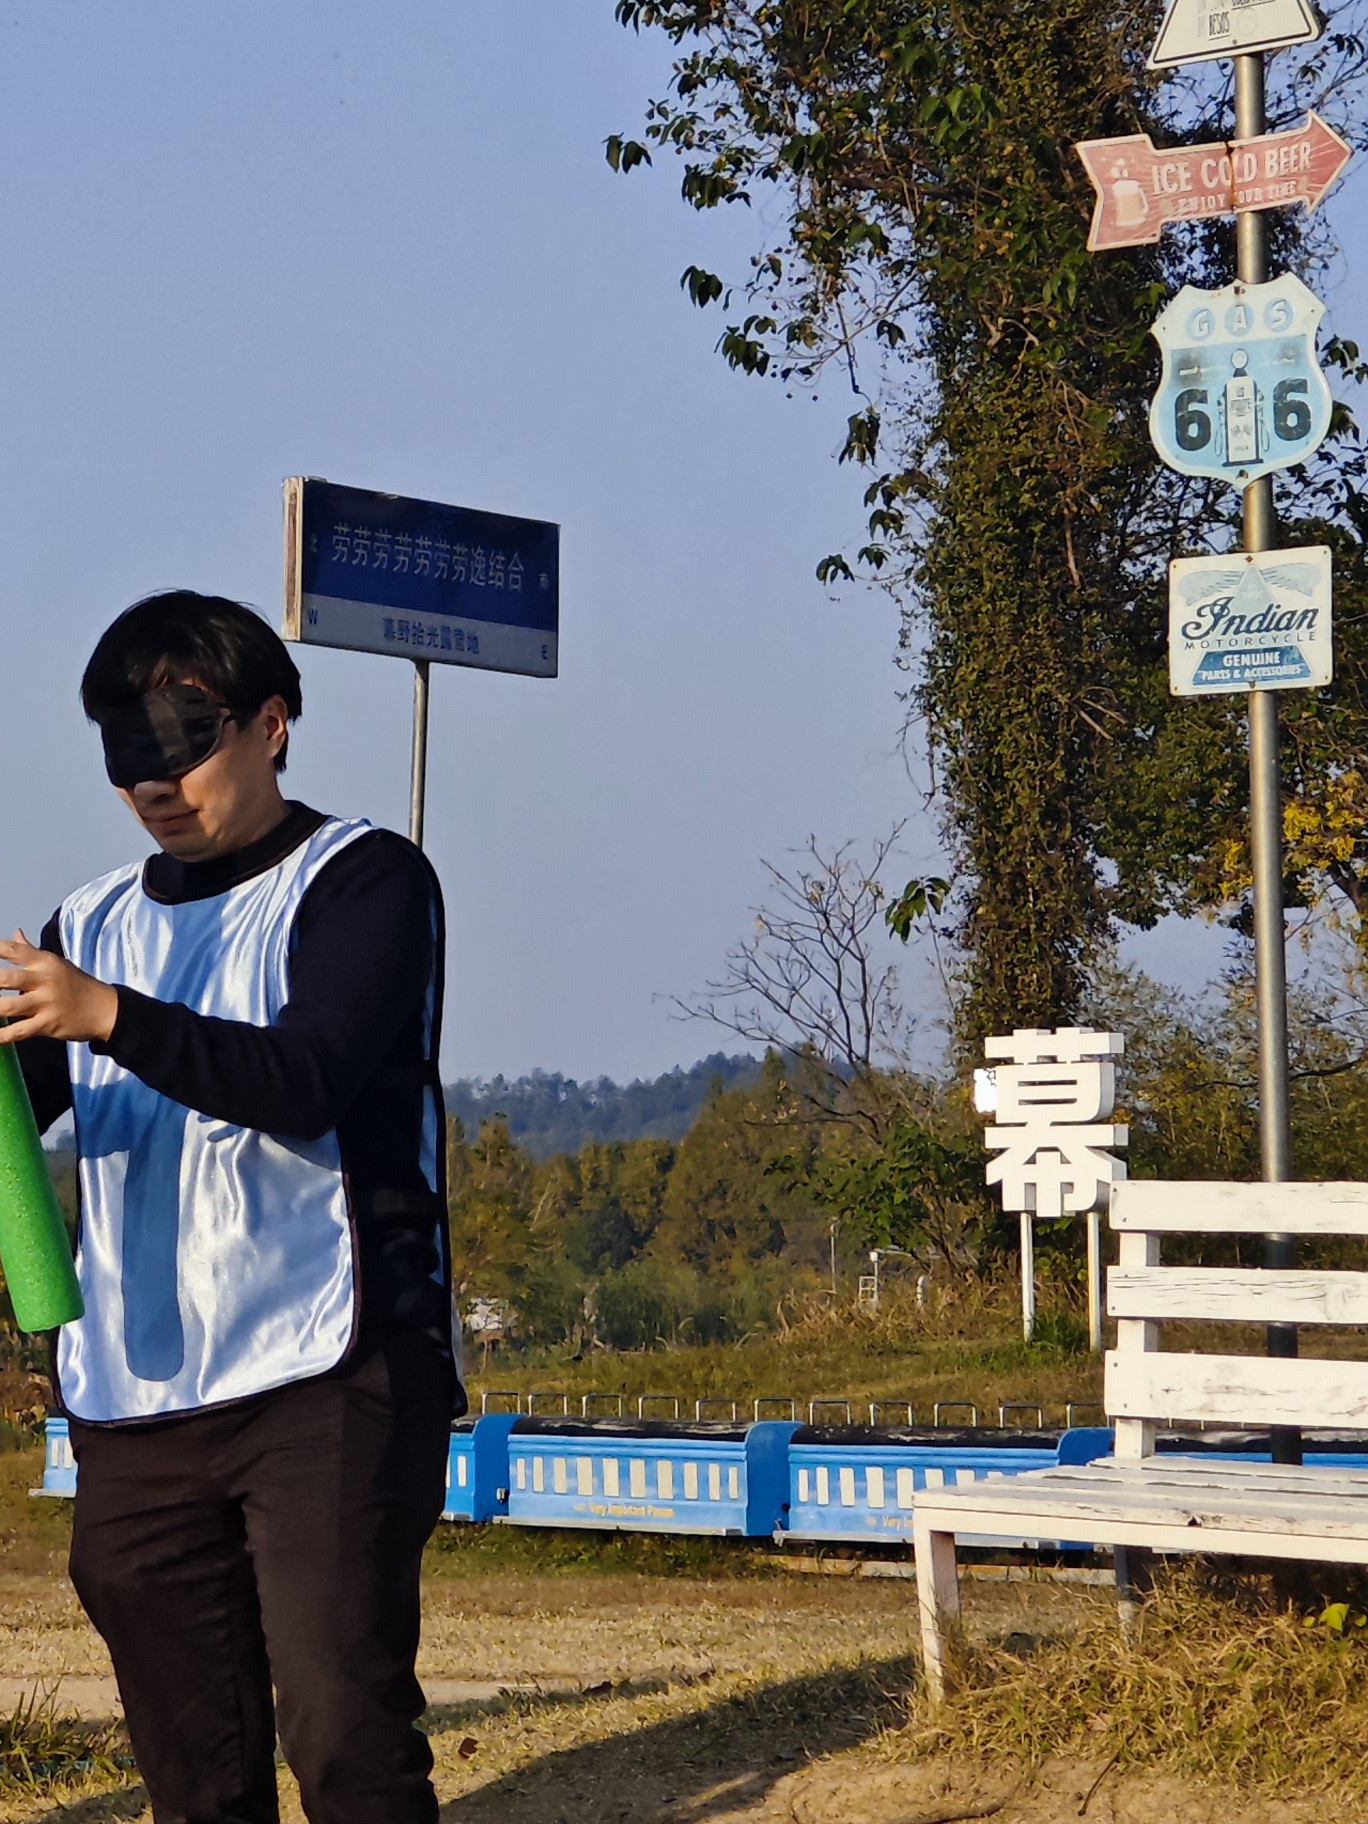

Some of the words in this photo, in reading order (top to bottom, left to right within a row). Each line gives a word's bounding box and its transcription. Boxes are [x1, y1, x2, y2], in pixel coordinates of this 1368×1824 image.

[1151, 164, 1193, 195] ICE
[1201, 152, 1258, 190] COLD
[1265, 141, 1312, 179] BEER
[1179, 194, 1226, 213] ENJOY
[1191, 299, 1288, 339] GAS
[1181, 596, 1320, 641] Indian
[1184, 631, 1317, 651] MOTORCYCLE
[1222, 651, 1281, 667] GENUINE
[984, 1026, 1129, 1218] 幕
